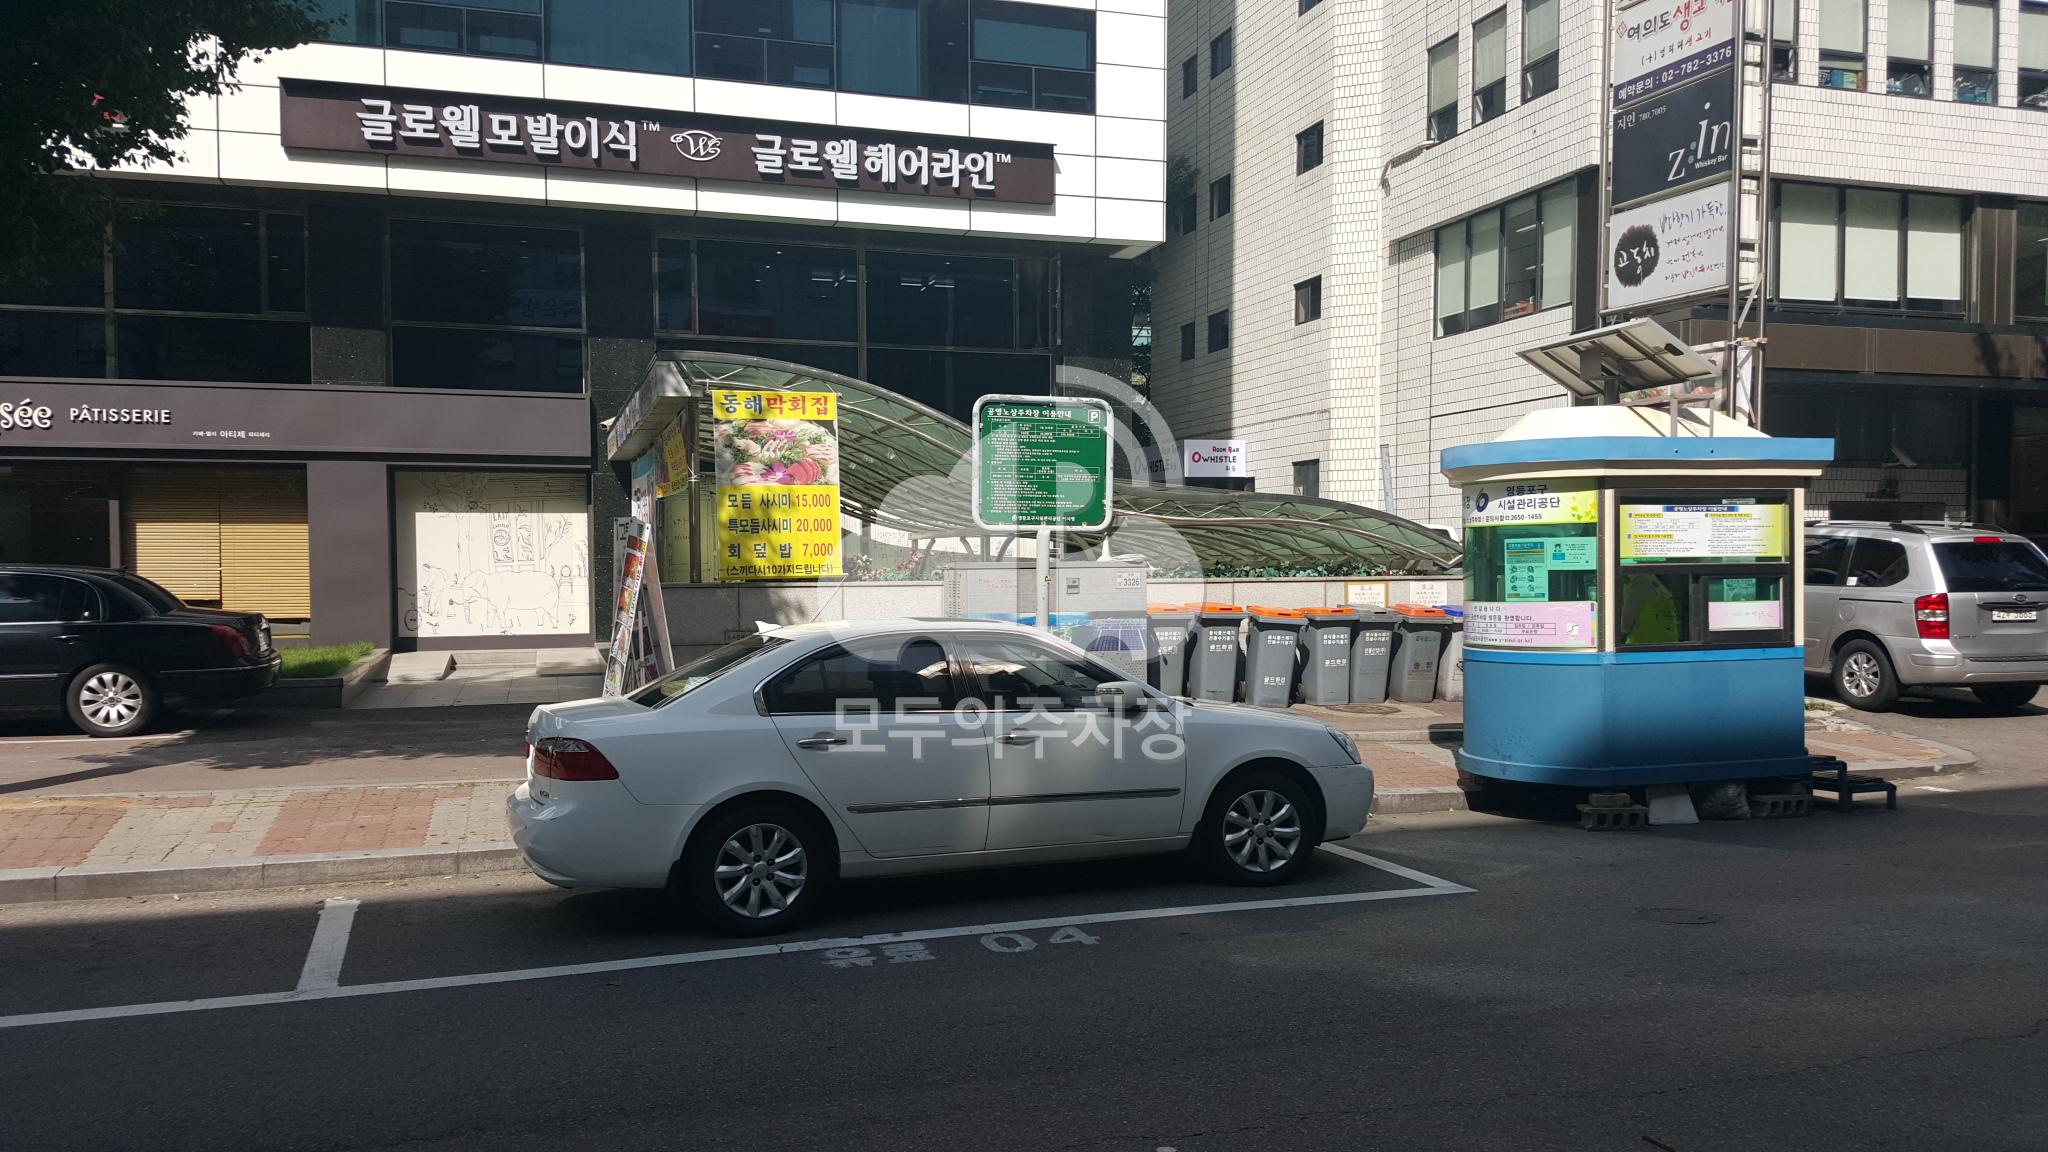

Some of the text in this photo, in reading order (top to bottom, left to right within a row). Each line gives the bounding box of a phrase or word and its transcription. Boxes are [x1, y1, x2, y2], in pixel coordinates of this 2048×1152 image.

[1618, 78, 1653, 100] 예약문의
[1661, 46, 1732, 83] 02-782-3376
[1617, 112, 1635, 130] 지인
[356, 98, 637, 162] 글로웰모발이식
[751, 134, 995, 190] 글로웰헤어라인
[1695, 158, 1717, 169] Whiskey
[720, 394, 829, 415] 동해막회집
[70, 405, 171, 424] PÂTISSERIE
[1506, 484, 1548, 496] 영등포구
[760, 493, 791, 508] 사시미
[796, 494, 831, 508] 15,000
[1498, 496, 1560, 510] 시설관리공단
[728, 518, 832, 534] 특모듬사시미 20,000
[802, 543, 833, 557] 7,000
